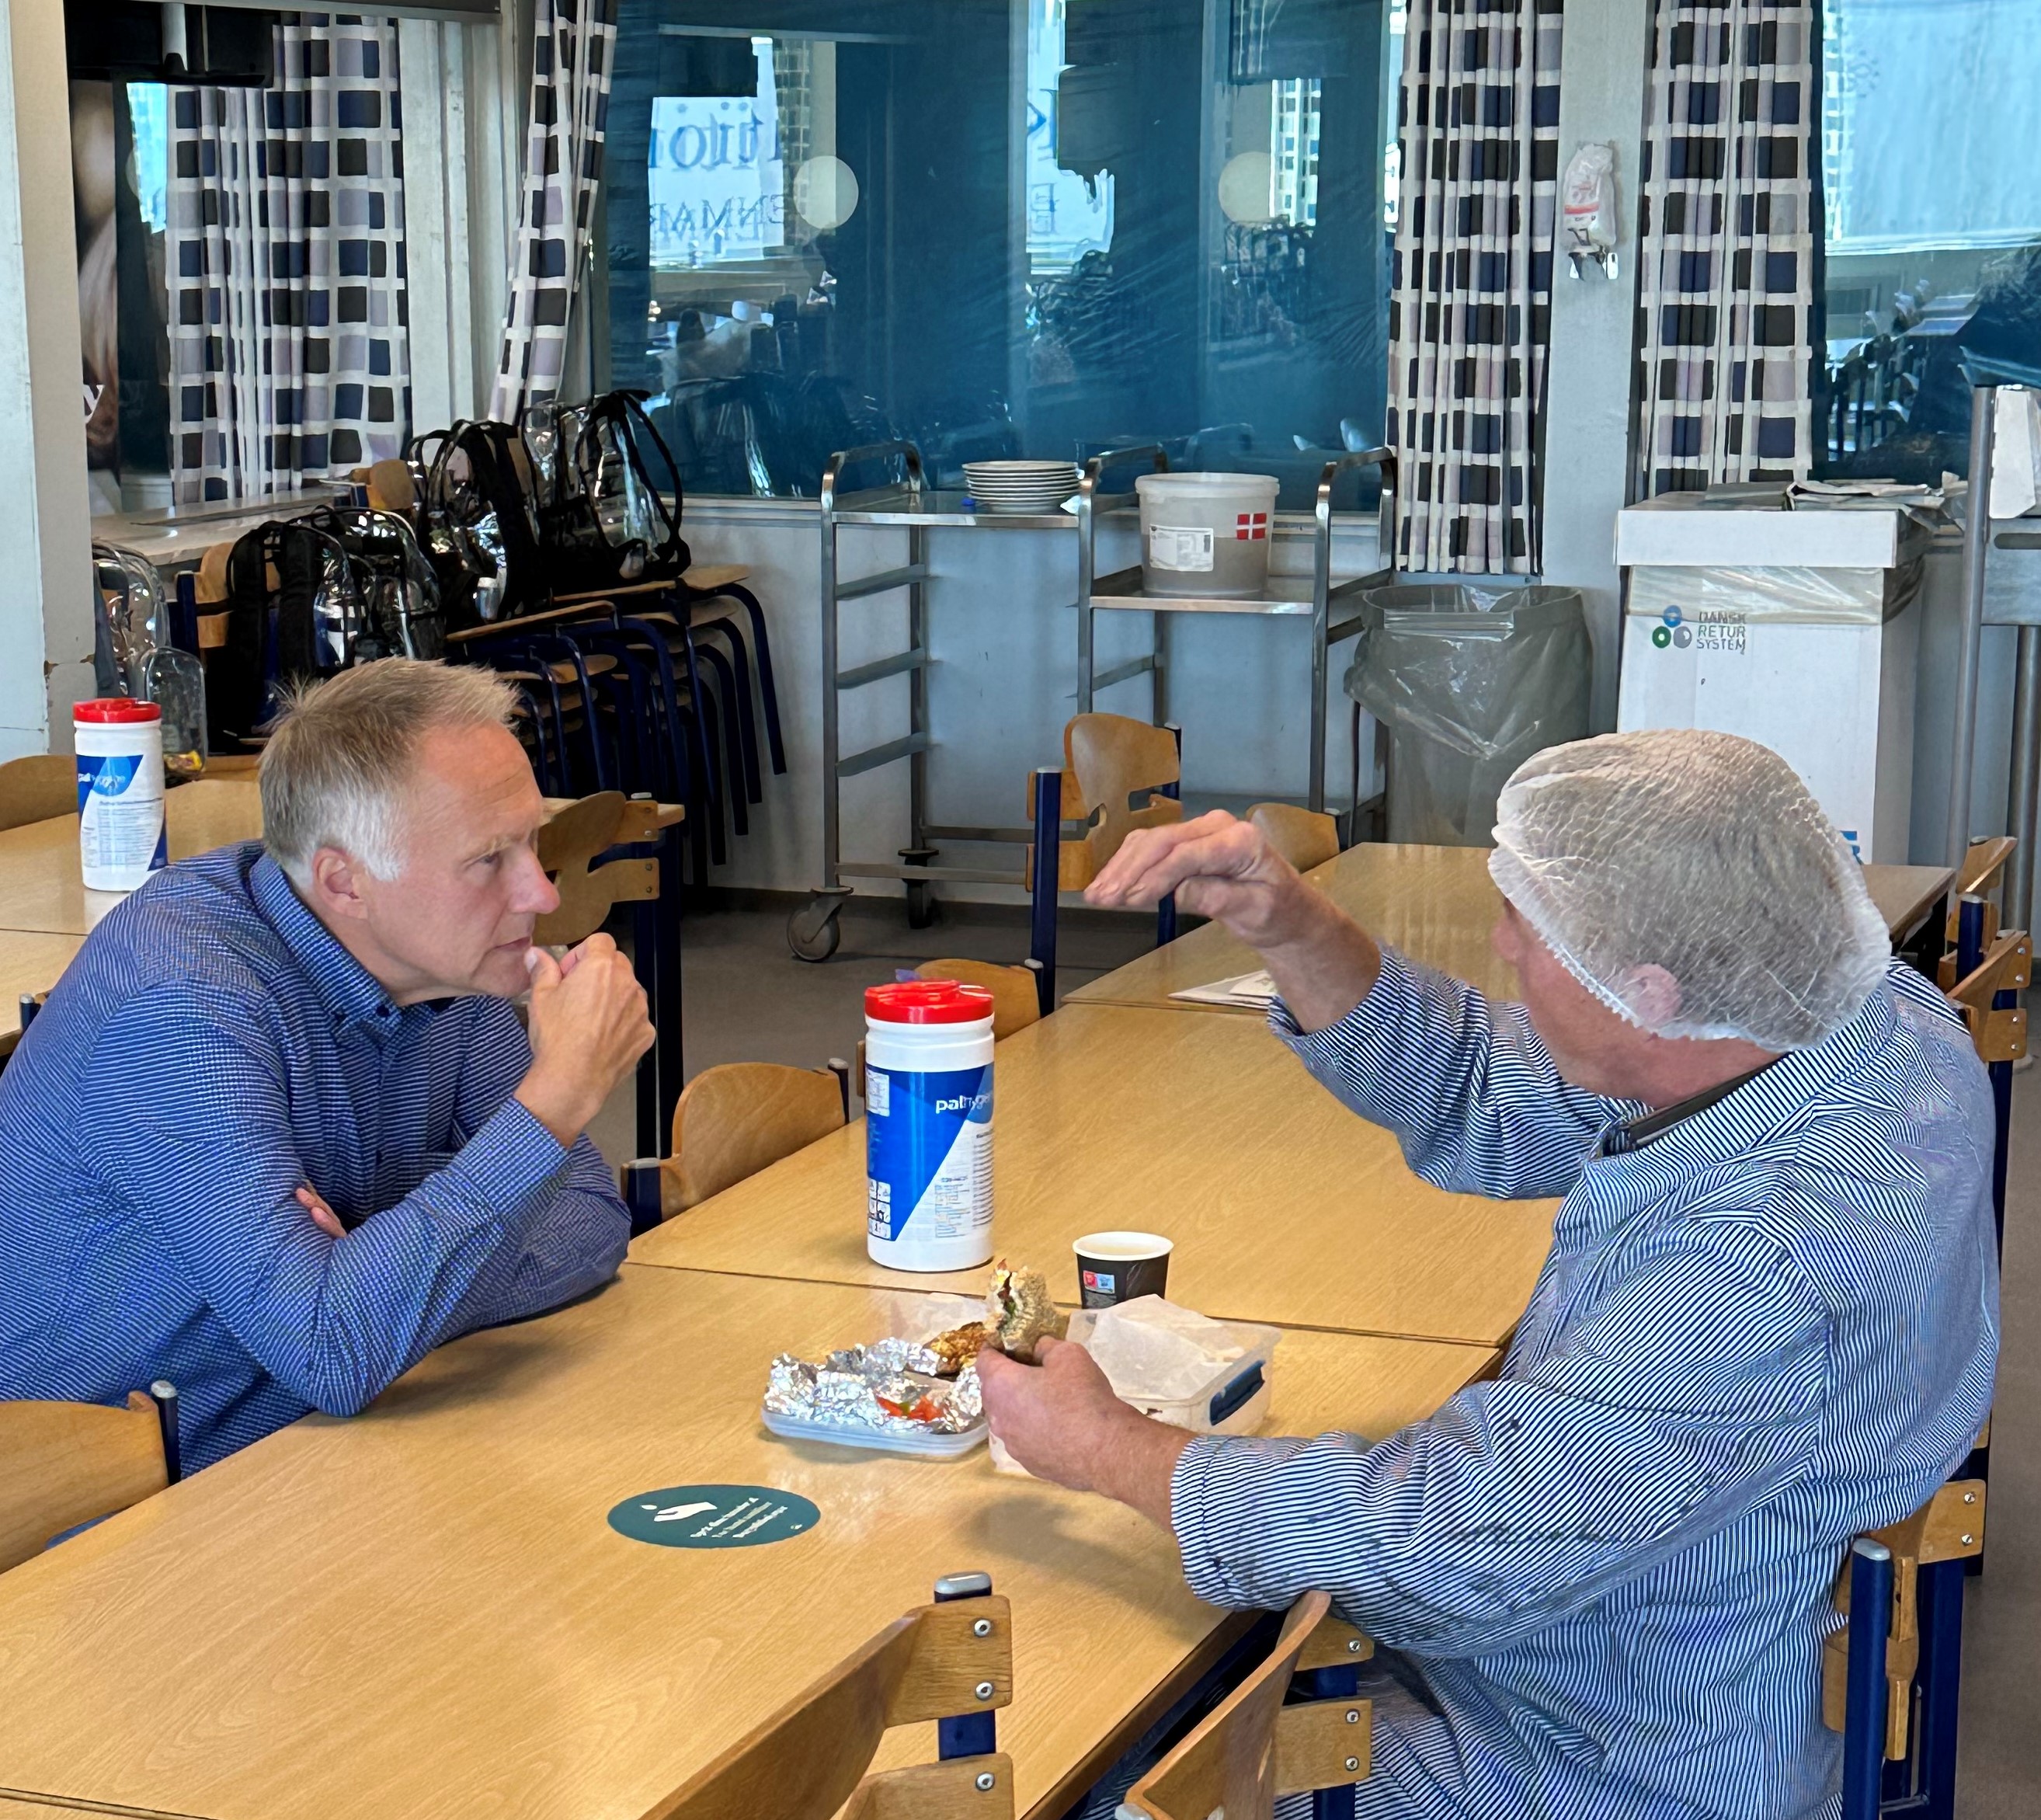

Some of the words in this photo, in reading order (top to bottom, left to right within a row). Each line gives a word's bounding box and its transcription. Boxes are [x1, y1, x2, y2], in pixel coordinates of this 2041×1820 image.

[1699, 611, 1746, 624] DANSK
[1698, 625, 1746, 638] RETUR
[1696, 638, 1746, 651] SYSTEM
